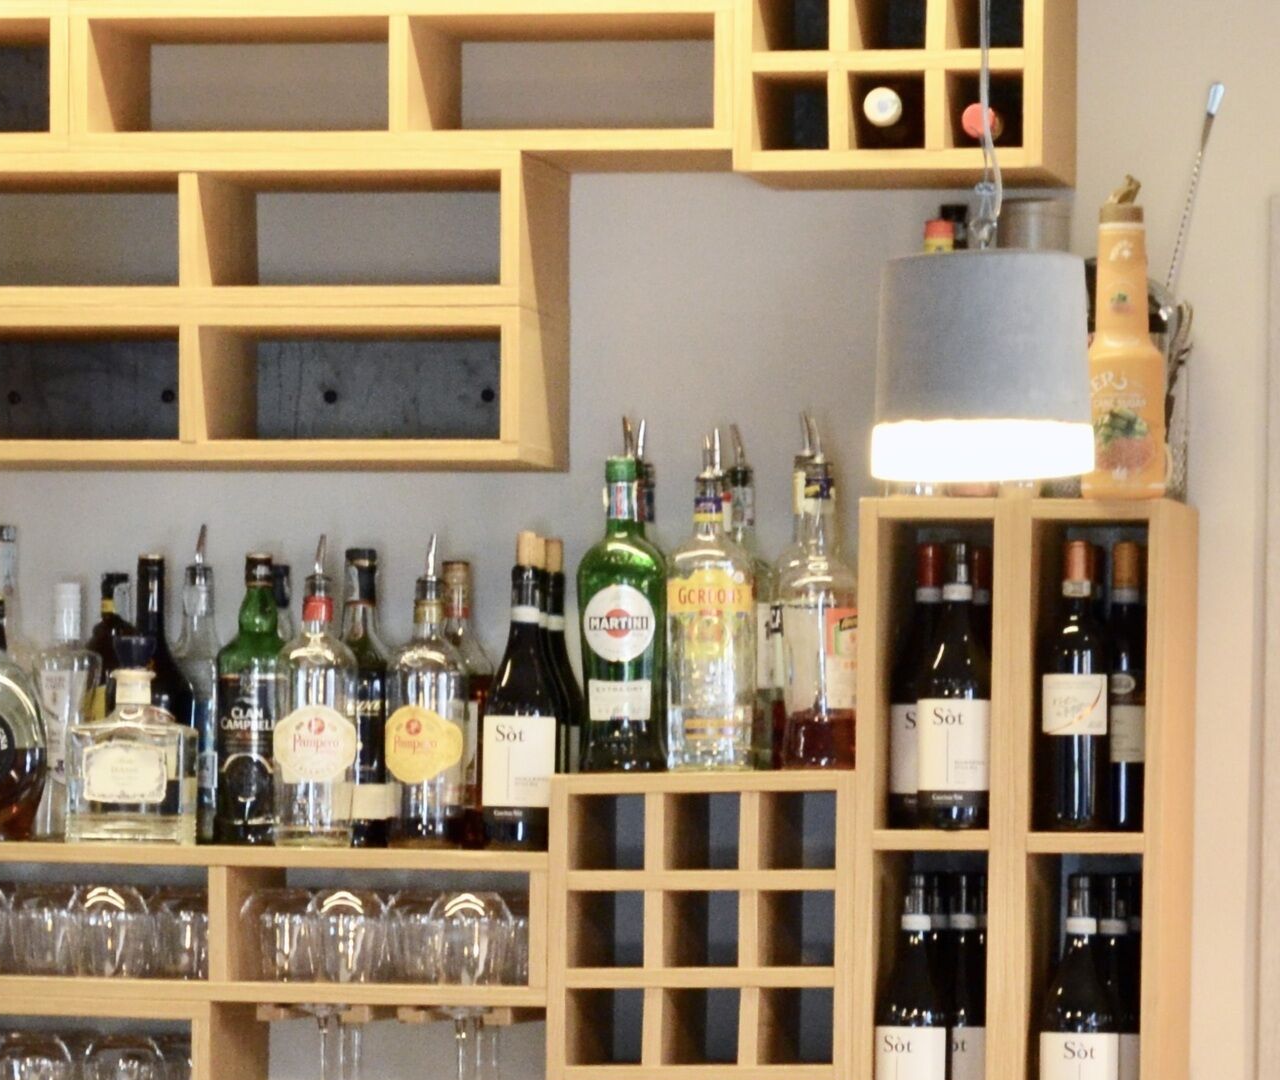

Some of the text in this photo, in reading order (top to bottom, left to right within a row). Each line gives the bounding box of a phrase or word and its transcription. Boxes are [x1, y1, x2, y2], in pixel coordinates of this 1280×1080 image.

[587, 615, 650, 632] MARTINI
[230, 705, 264, 721] CLAN
[932, 706, 965, 727] Sòt
[292, 733, 340, 753] Pampero
[494, 723, 525, 743] Sòt
[882, 1034, 914, 1054] Sòt
[1063, 1040, 1096, 1061] Sòt
